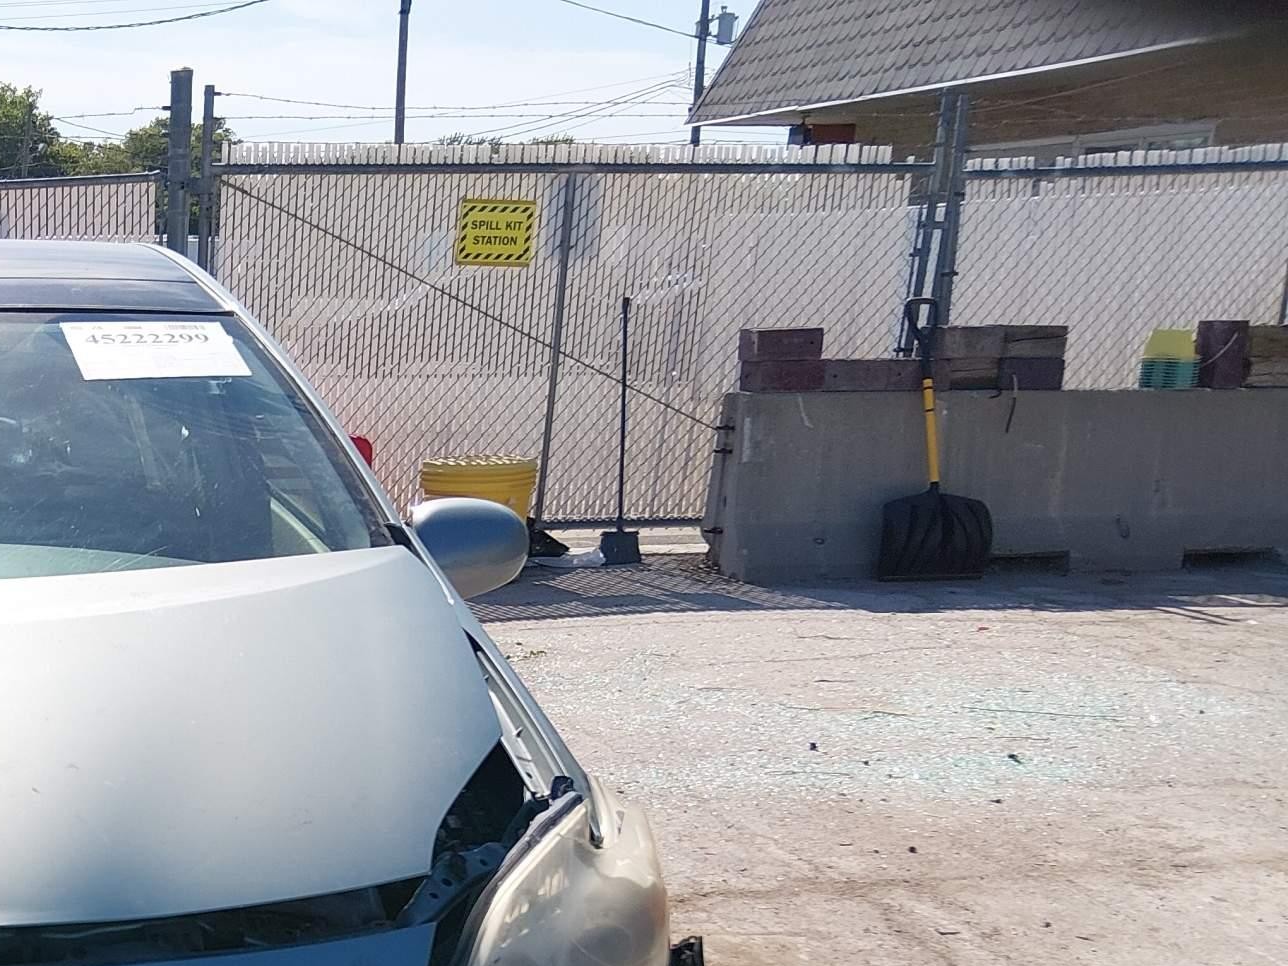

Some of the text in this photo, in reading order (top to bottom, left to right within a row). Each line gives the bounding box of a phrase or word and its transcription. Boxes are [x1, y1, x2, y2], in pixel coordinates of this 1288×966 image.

[470, 220, 524, 231] SPILL KIT
[472, 235, 518, 246] STATION
[85, 333, 209, 345] 45222299
